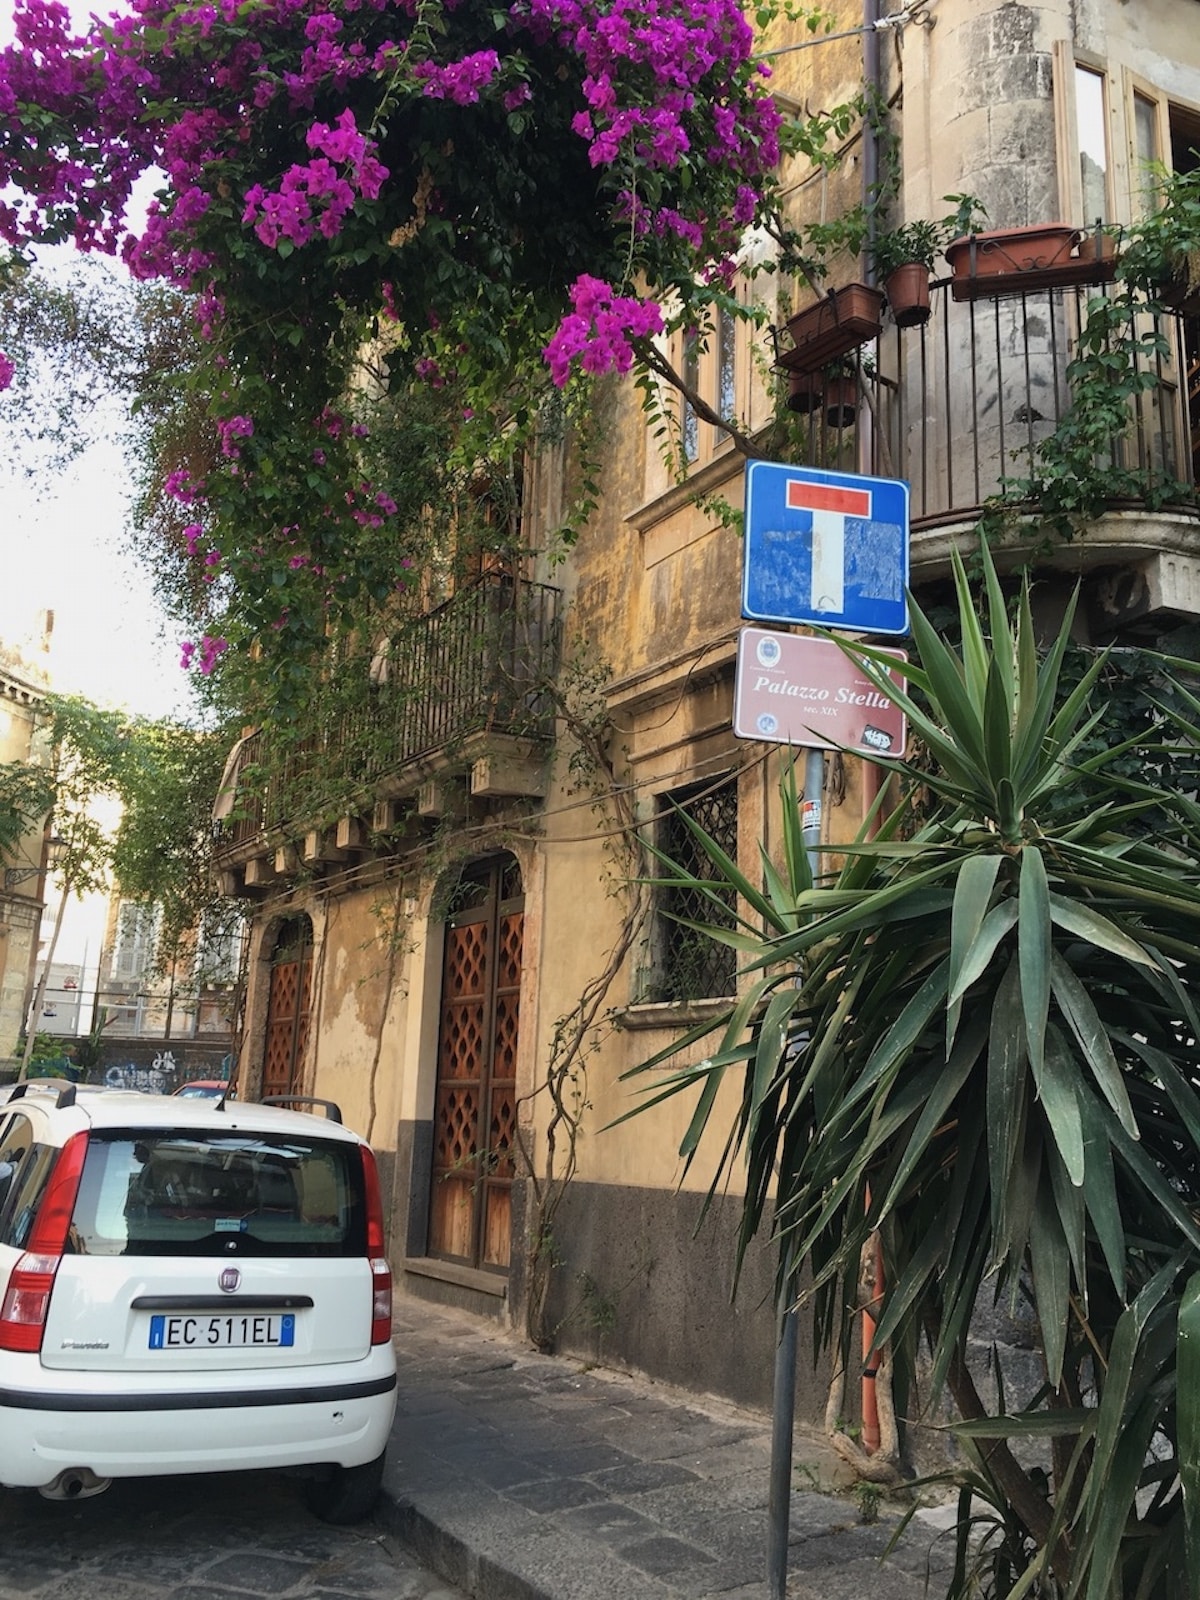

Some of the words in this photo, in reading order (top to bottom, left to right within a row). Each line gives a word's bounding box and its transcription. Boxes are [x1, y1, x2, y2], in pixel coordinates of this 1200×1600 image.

[752, 676, 830, 701] Palazzo
[834, 687, 892, 710] Stella
[821, 706, 839, 717] XIX
[167, 1319, 197, 1345] EC
[207, 1317, 279, 1344] 511EL
